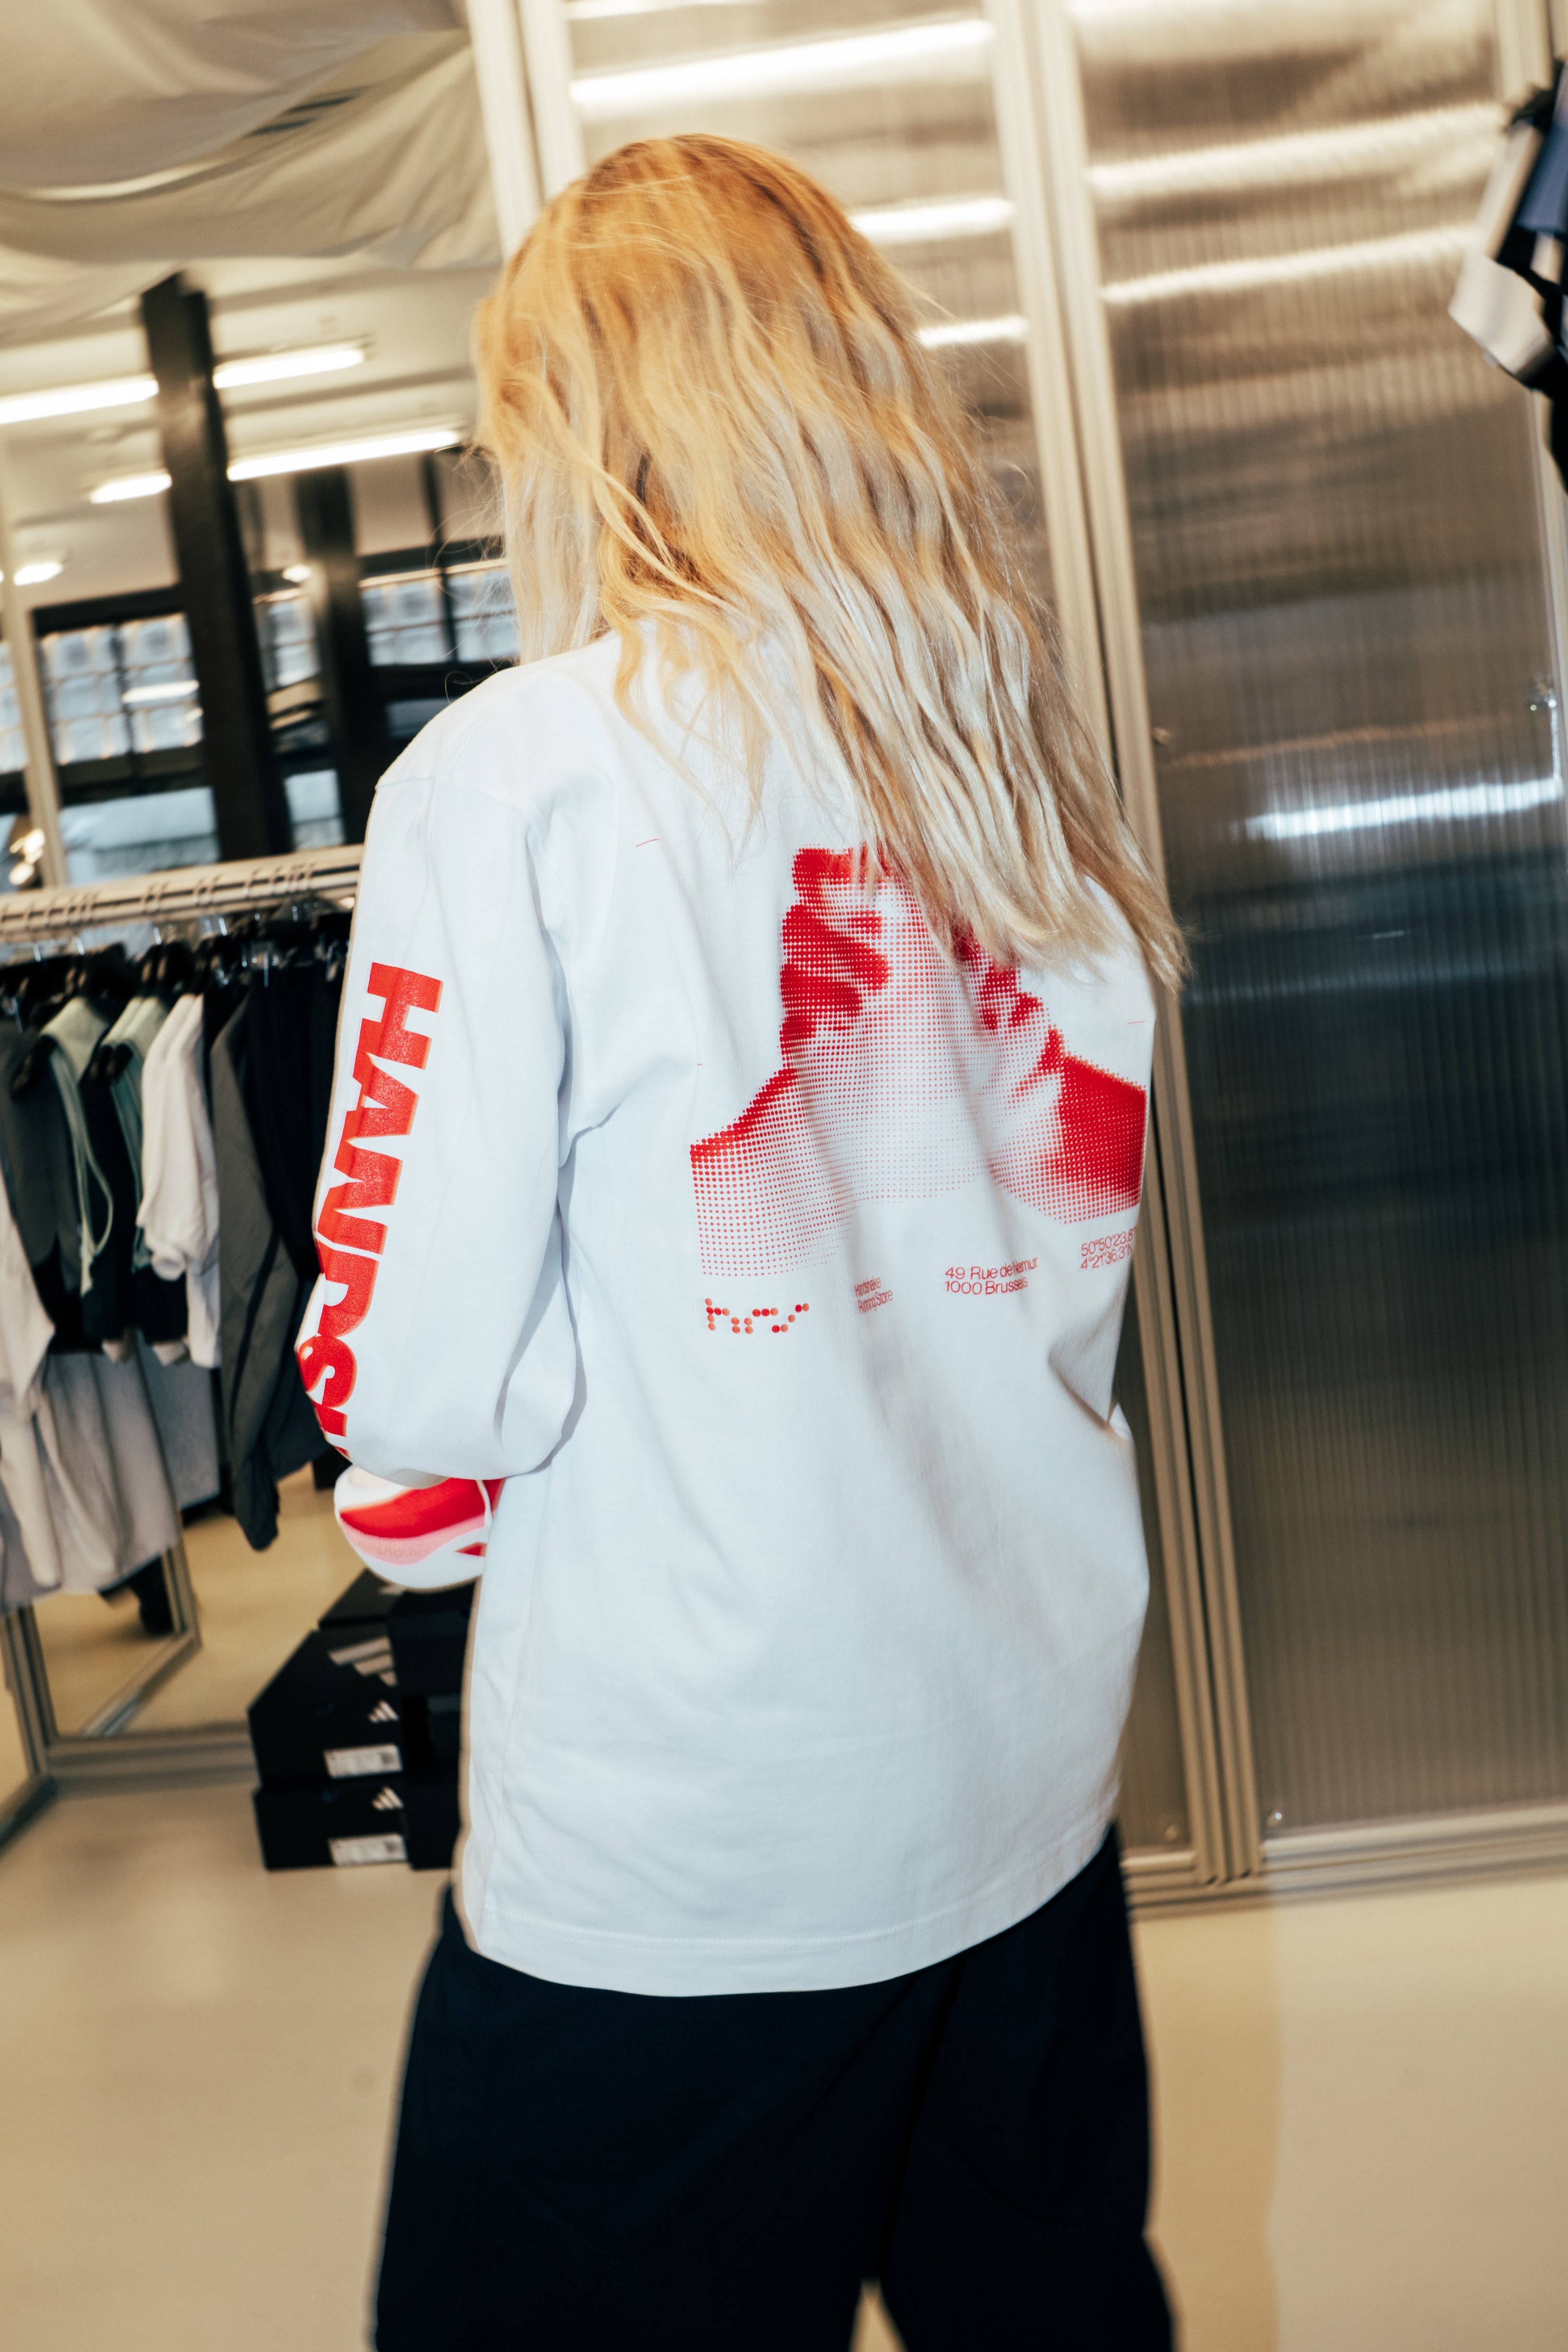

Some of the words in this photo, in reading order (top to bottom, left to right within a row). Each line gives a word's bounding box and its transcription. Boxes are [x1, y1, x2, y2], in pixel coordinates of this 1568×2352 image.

[944, 1266, 966, 1279] 49
[970, 1266, 998, 1280] Rue
[999, 1263, 1012, 1277] de
[1011, 1257, 1038, 1274] Namur
[854, 1275, 882, 1298] Handshake
[944, 1280, 983, 1295] 1000
[985, 1275, 1029, 1295] Brussels
[857, 1297, 878, 1315] Running
[874, 1290, 893, 1307] Store
